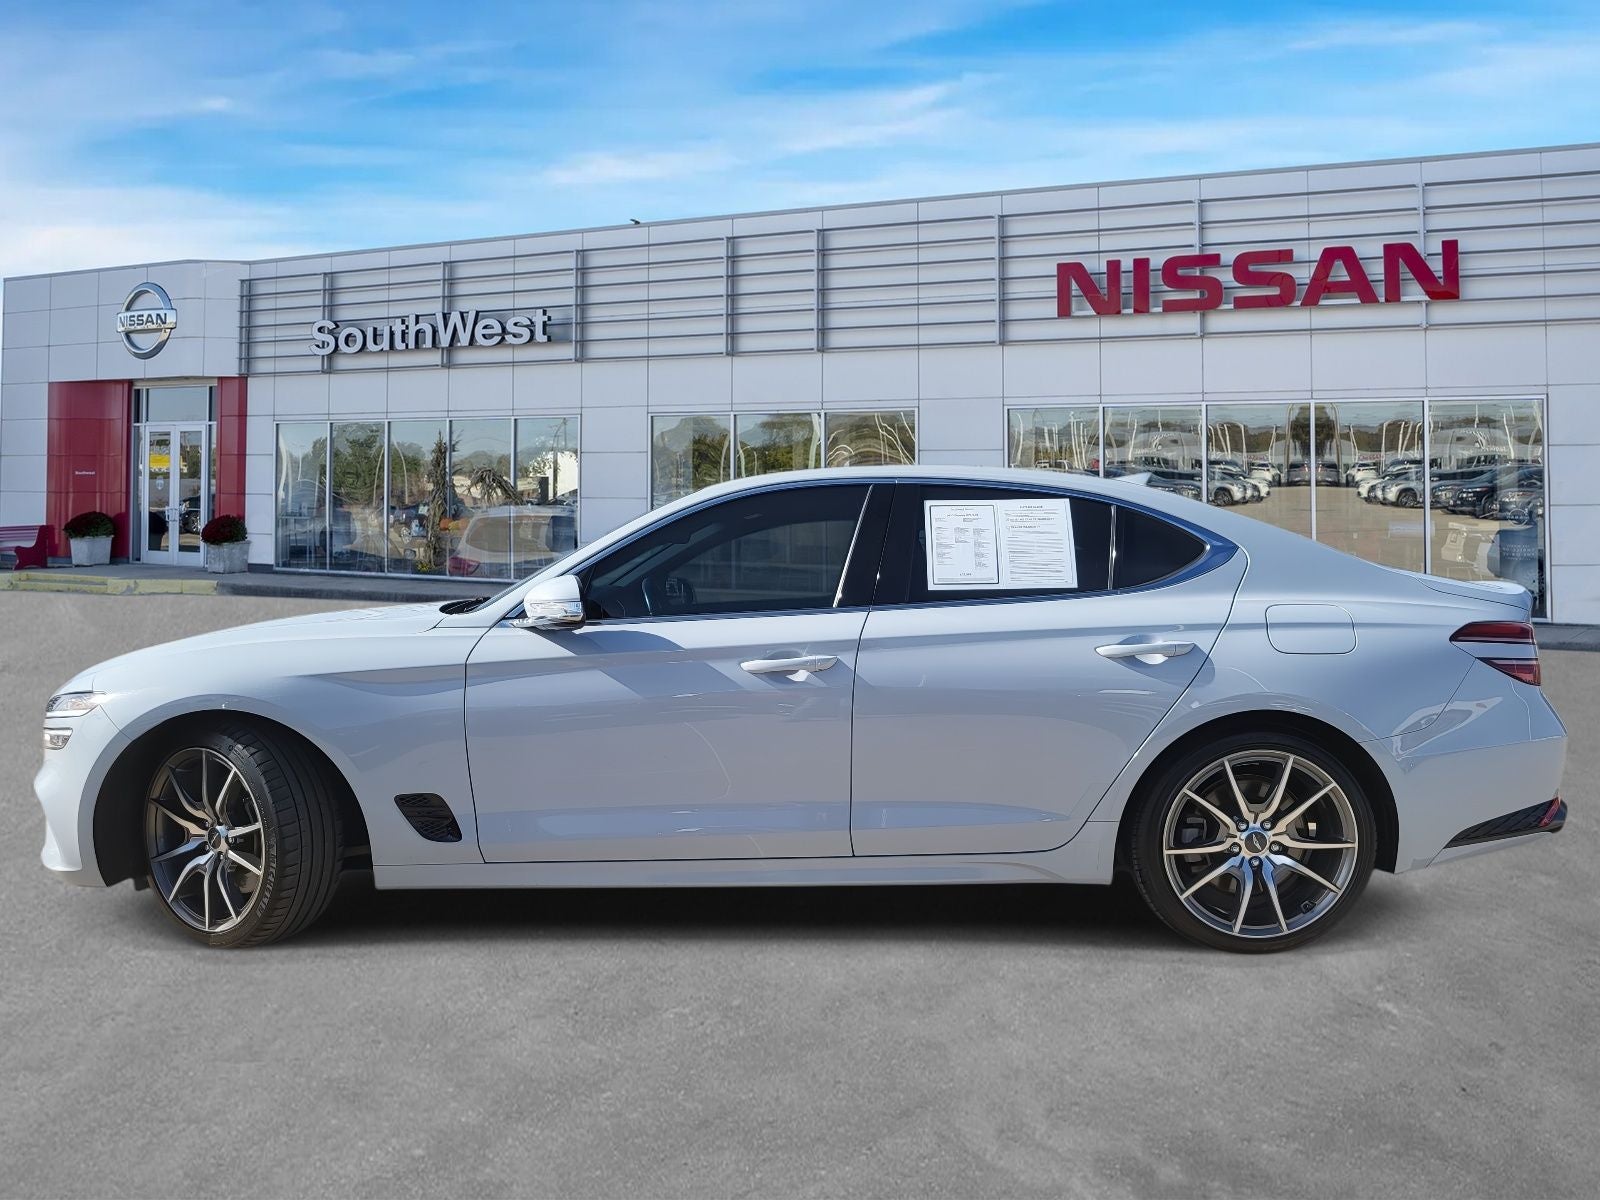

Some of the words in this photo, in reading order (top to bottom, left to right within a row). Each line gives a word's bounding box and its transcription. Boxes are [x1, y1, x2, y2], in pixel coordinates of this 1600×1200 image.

[1056, 239, 1460, 318] NISSAN
[118, 312, 168, 328] NISSAN
[310, 308, 552, 356] SouthWest
